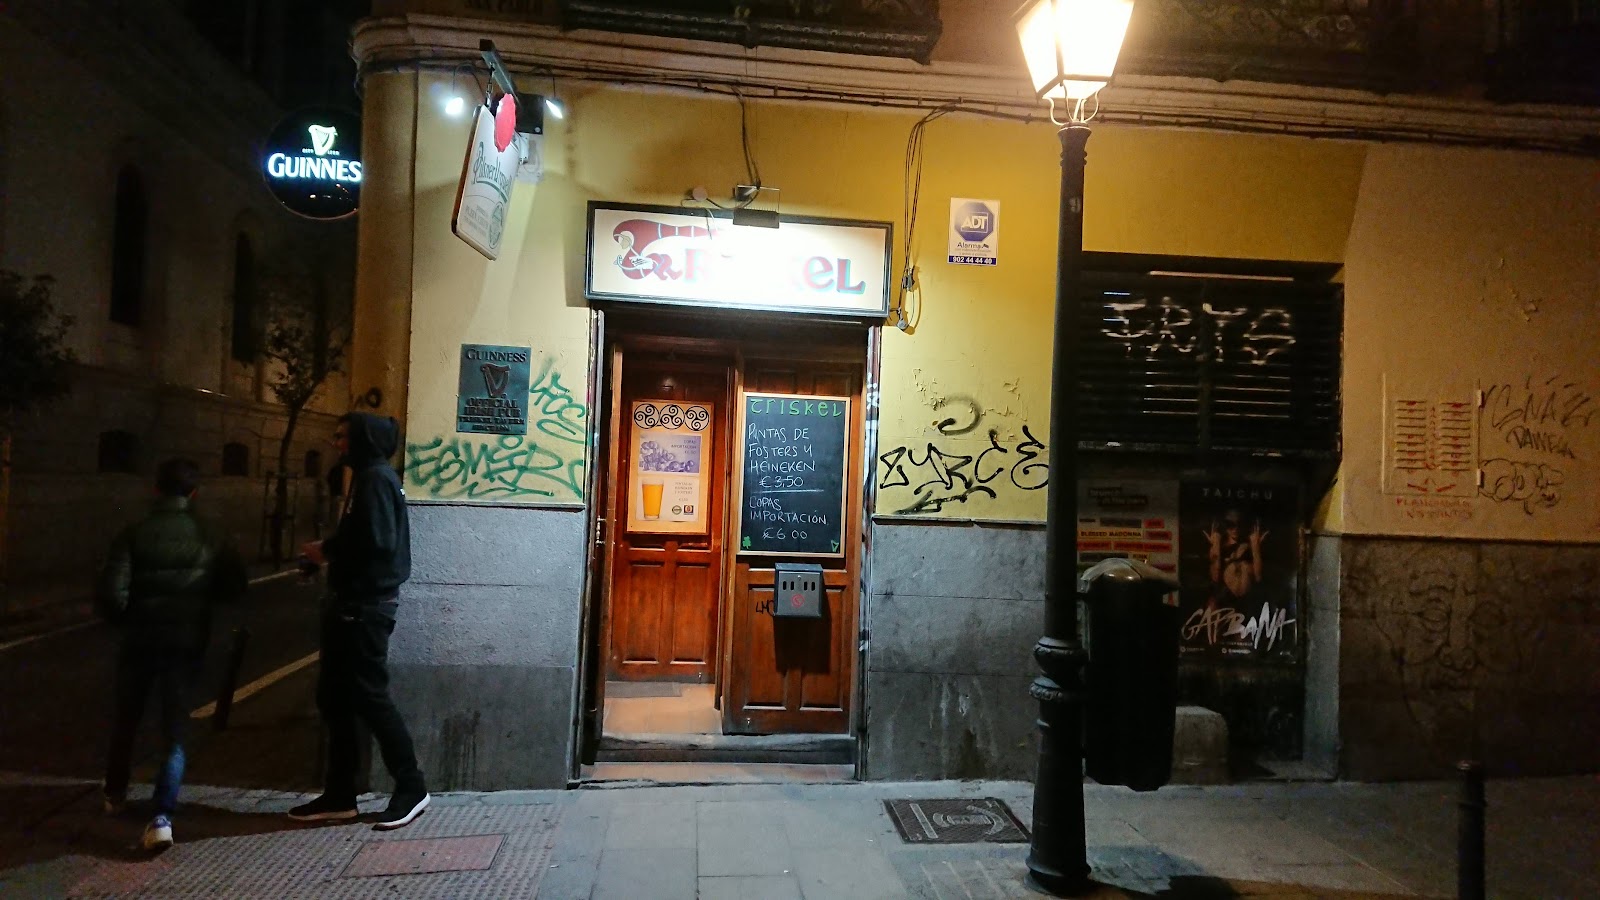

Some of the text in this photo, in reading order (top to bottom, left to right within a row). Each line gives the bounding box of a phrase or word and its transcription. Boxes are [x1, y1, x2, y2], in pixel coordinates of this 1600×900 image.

[267, 153, 362, 182] GUINNES
[961, 215, 988, 230] ADT
[465, 347, 527, 363] GUINNESS
[498, 407, 521, 418] PUB
[748, 422, 809, 443] PINTAS DE
[748, 443, 798, 460] FOSTERS
[750, 459, 816, 475] HEINEKEN
[1203, 487, 1273, 500] TAICHU
[750, 496, 782, 511] COPAS
[750, 509, 828, 524] IMPORTACIÓN
